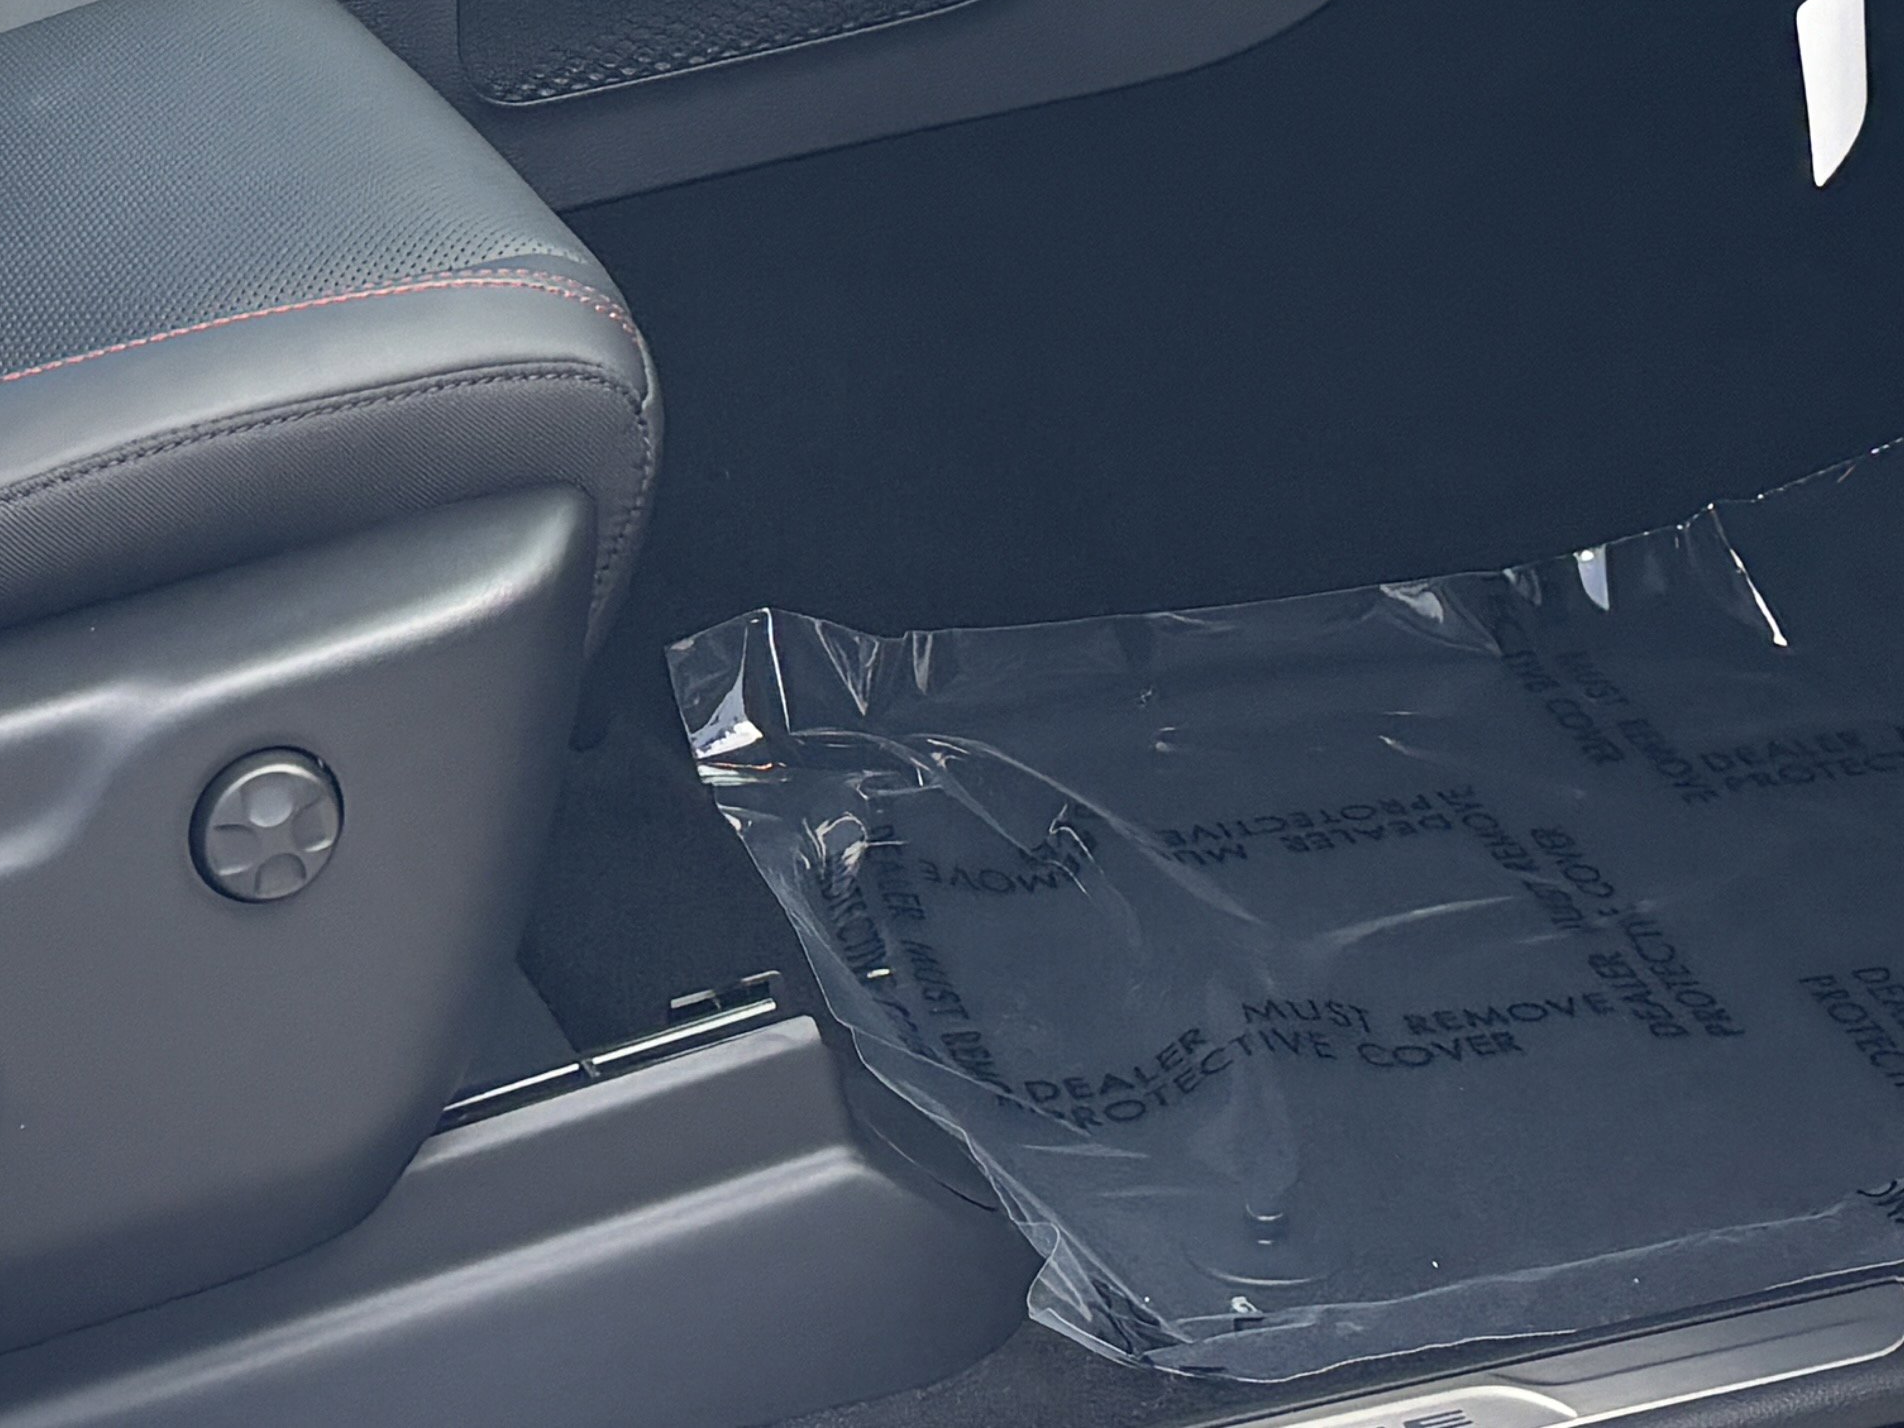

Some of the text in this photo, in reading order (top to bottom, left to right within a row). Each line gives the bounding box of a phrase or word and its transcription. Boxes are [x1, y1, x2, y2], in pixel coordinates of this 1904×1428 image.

[1024, 993, 1617, 1105] DEALER MUST REMOVE
[1357, 1032, 1525, 1068] COVER
